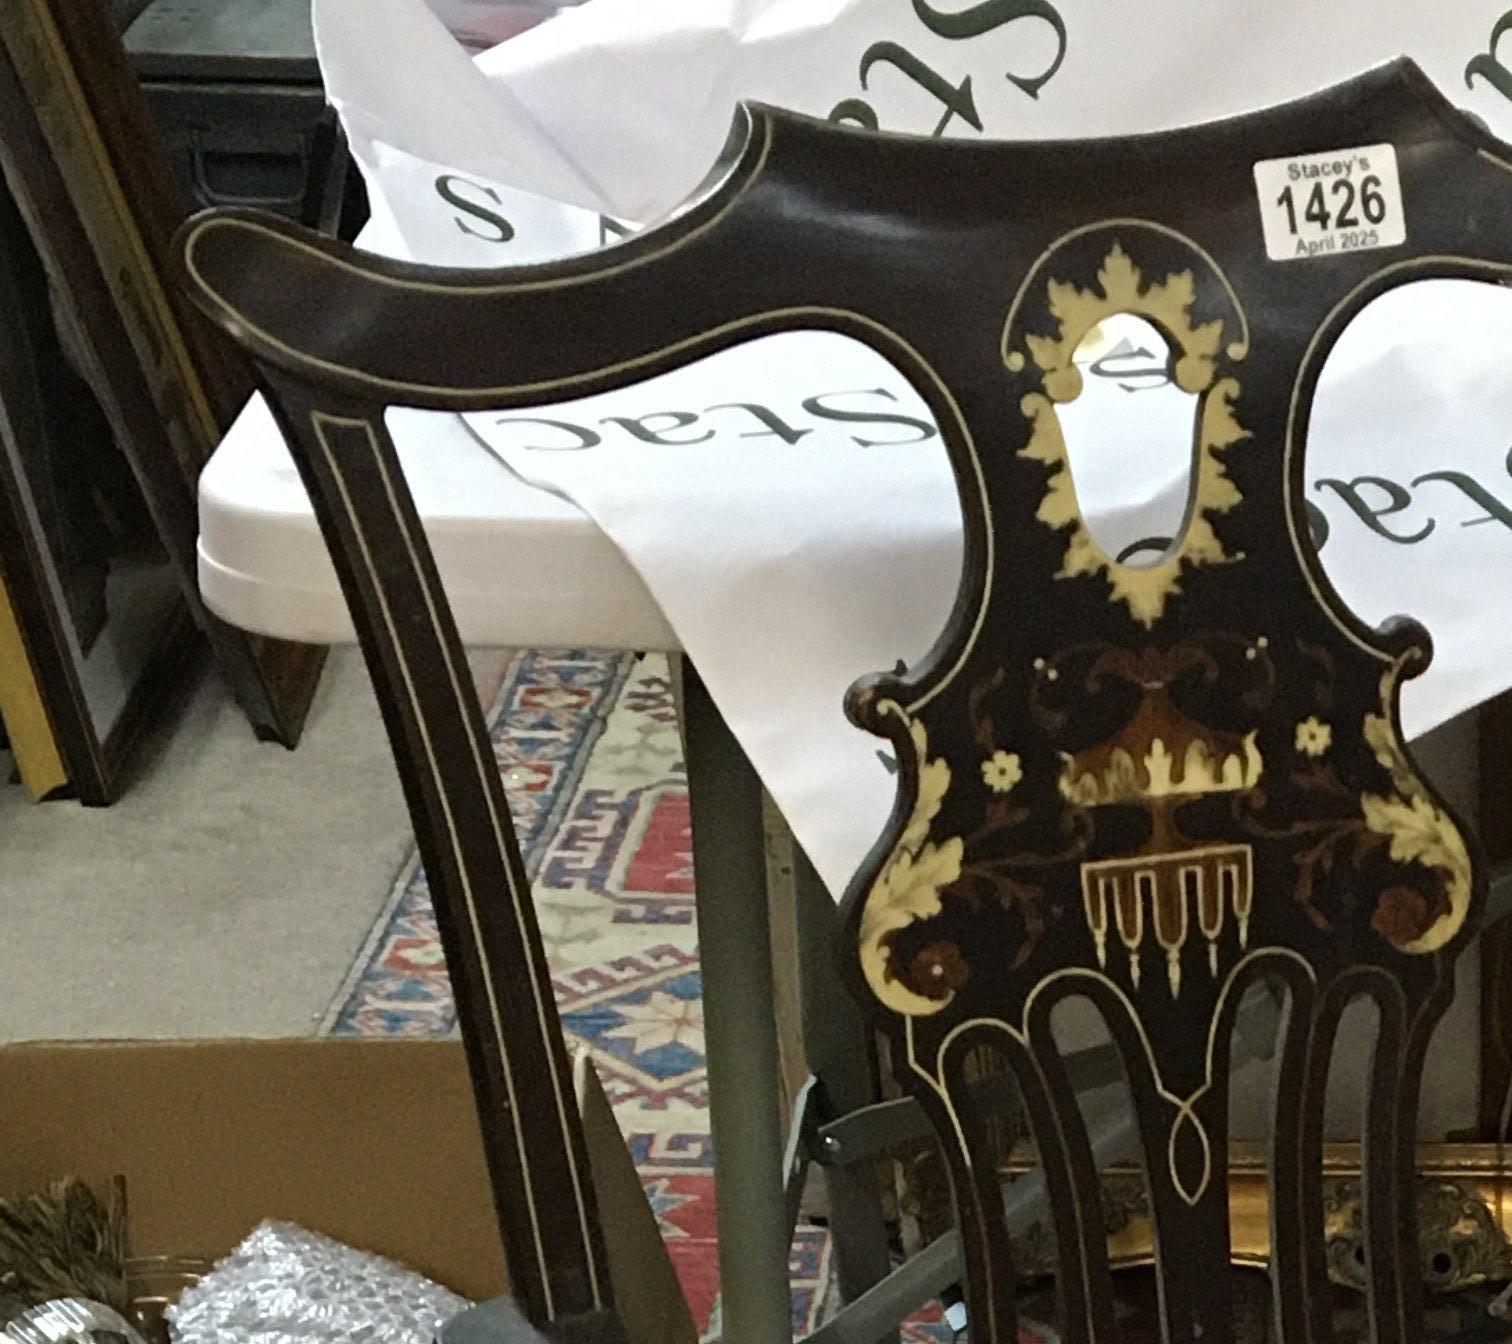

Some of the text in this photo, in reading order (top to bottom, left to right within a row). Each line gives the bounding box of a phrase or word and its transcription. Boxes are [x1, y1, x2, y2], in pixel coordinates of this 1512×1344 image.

[1287, 154, 1371, 181] Stacey's
[1276, 174, 1386, 235] 1426
[1295, 229, 1380, 258] April 2025
